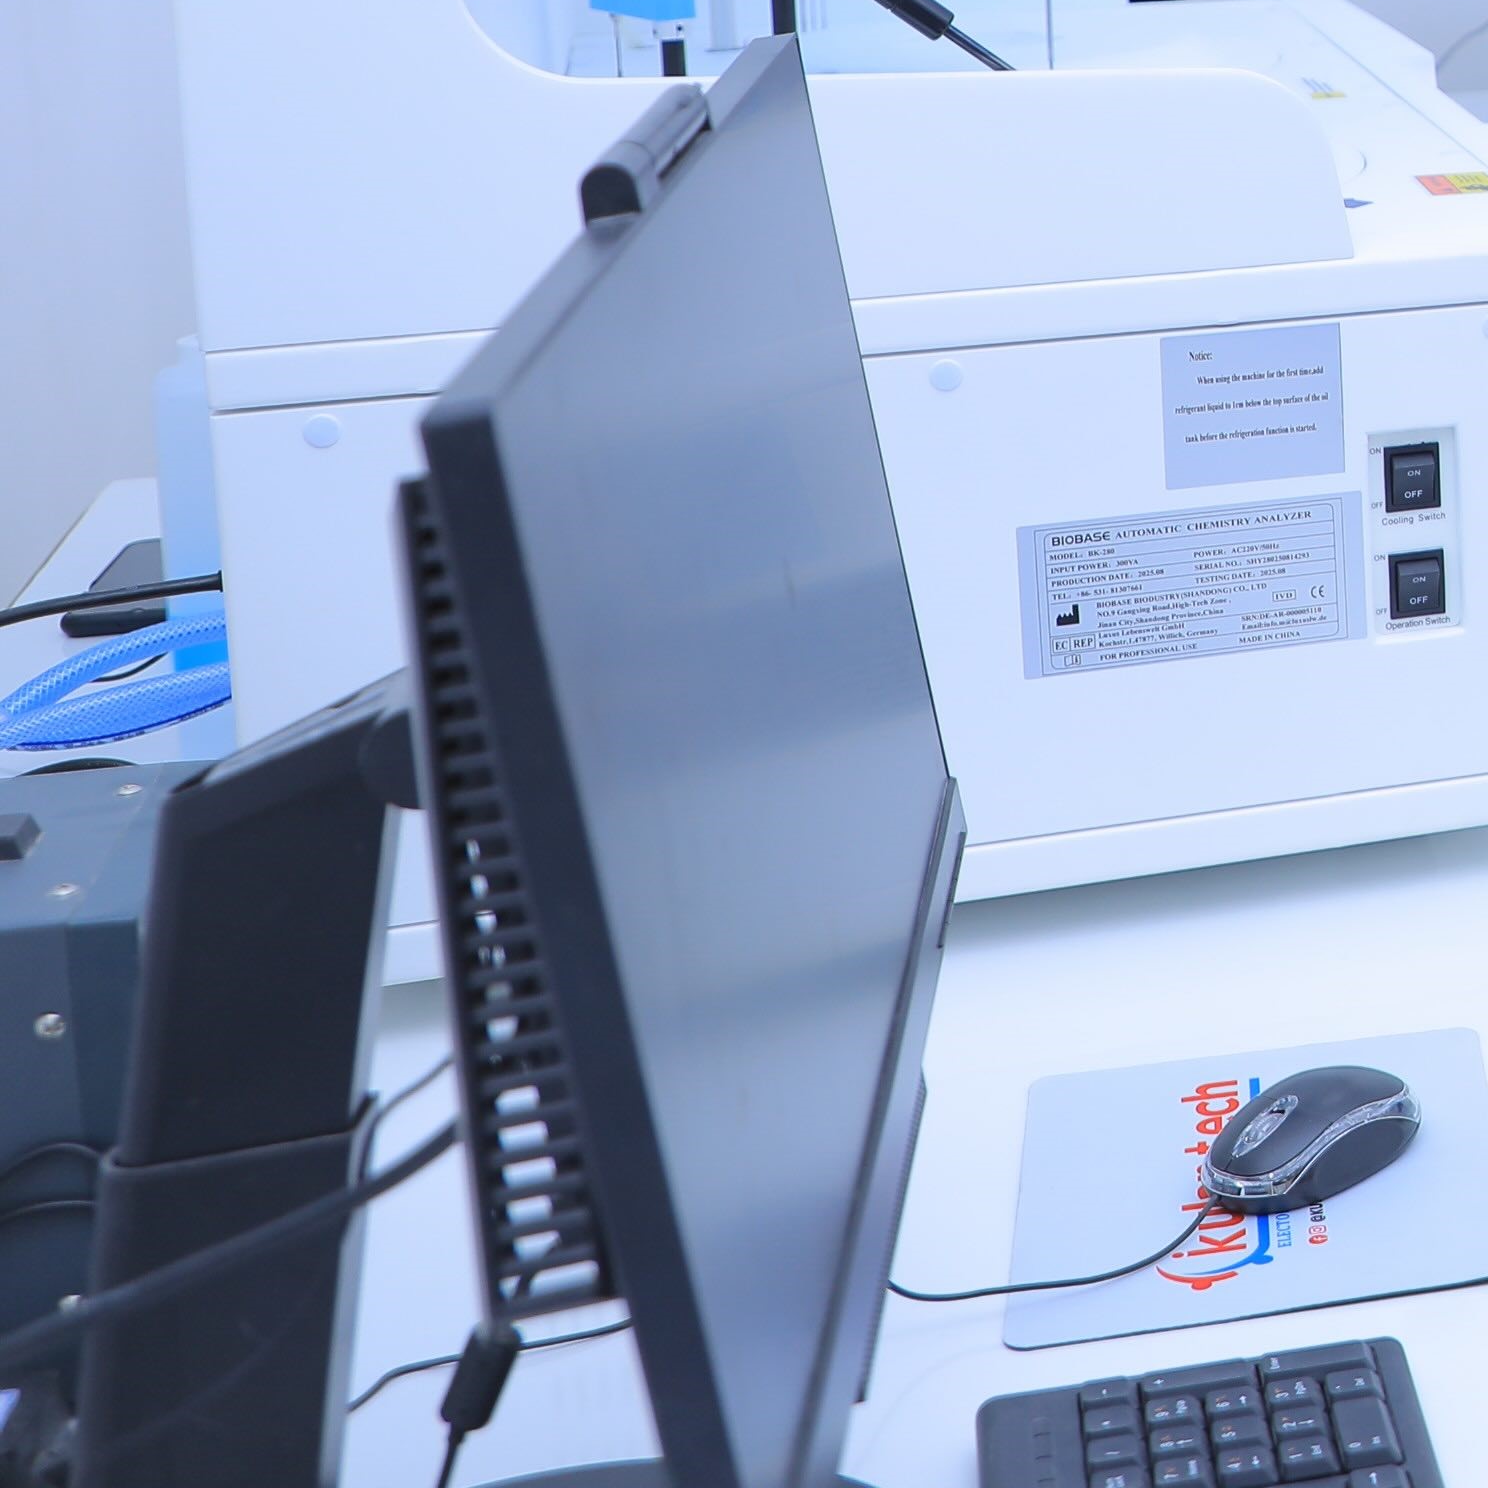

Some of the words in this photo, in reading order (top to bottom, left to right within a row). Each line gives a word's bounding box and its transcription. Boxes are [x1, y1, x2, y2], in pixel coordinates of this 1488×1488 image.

[1188, 351, 1213, 362] Notice:
[1197, 375, 1214, 385] When
[1215, 375, 1230, 384] using
[1231, 373, 1240, 382] the
[1242, 371, 1265, 381] machine
[1267, 370, 1275, 378] for
[1276, 369, 1285, 377] the
[1286, 368, 1298, 376] first
[1175, 403, 1206, 415] refrigerant
[1207, 402, 1224, 413] liquid
[1245, 399, 1261, 408] below
[1263, 398, 1271, 406] the
[1273, 397, 1282, 407] top
[1283, 395, 1303, 404] surface
[1304, 393, 1310, 402] of
[1311, 393, 1320, 401] the
[1185, 434, 1199, 443] tank
[1200, 432, 1217, 442] before
[1219, 431, 1228, 439] the
[1229, 427, 1264, 439] refrigeration
[1266, 426, 1289, 435] function
[1290, 424, 1294, 433] is
[1369, 447, 1381, 455] ON
[1407, 469, 1421, 477] ON
[1404, 490, 1423, 499] OFF
[1371, 501, 1383, 509] OFF
[1381, 516, 1414, 526] Cooling
[1418, 512, 1446, 522] Switch
[1051, 531, 1111, 547] BIOBASE
[1115, 525, 1181, 540] AUTOMATIC
[1187, 517, 1251, 531] CHEMISTRY
[1254, 511, 1312, 524] ANALYZER
[1373, 554, 1386, 562] ON
[1050, 565, 1076, 575] INPUT
[1115, 559, 1138, 568] 300VA
[1194, 560, 1224, 571] SERIAL
[1051, 575, 1107, 588] PRODUCTION
[1195, 574, 1230, 584] TESTING
[1096, 598, 1131, 608] BIOBASE
[1251, 583, 1267, 591] LTD
[1275, 592, 1293, 600] IVD
[1310, 585, 1325, 599] CE
[1409, 595, 1428, 605] OFF
[1097, 619, 1117, 629] Jinan
[1162, 623, 1185, 632] GmbH
[1385, 619, 1424, 631] Operation
[1425, 616, 1451, 625] Switch
[1186, 628, 1218, 638] Germany
[1239, 634, 1263, 644] MADE
[1264, 633, 1273, 641] IN
[1275, 631, 1301, 640] CHINA
[1055, 640, 1068, 651] EC
[1073, 638, 1094, 649] REP
[1118, 646, 1181, 659] PROFESSIONAL
[1182, 643, 1197, 651] USE
